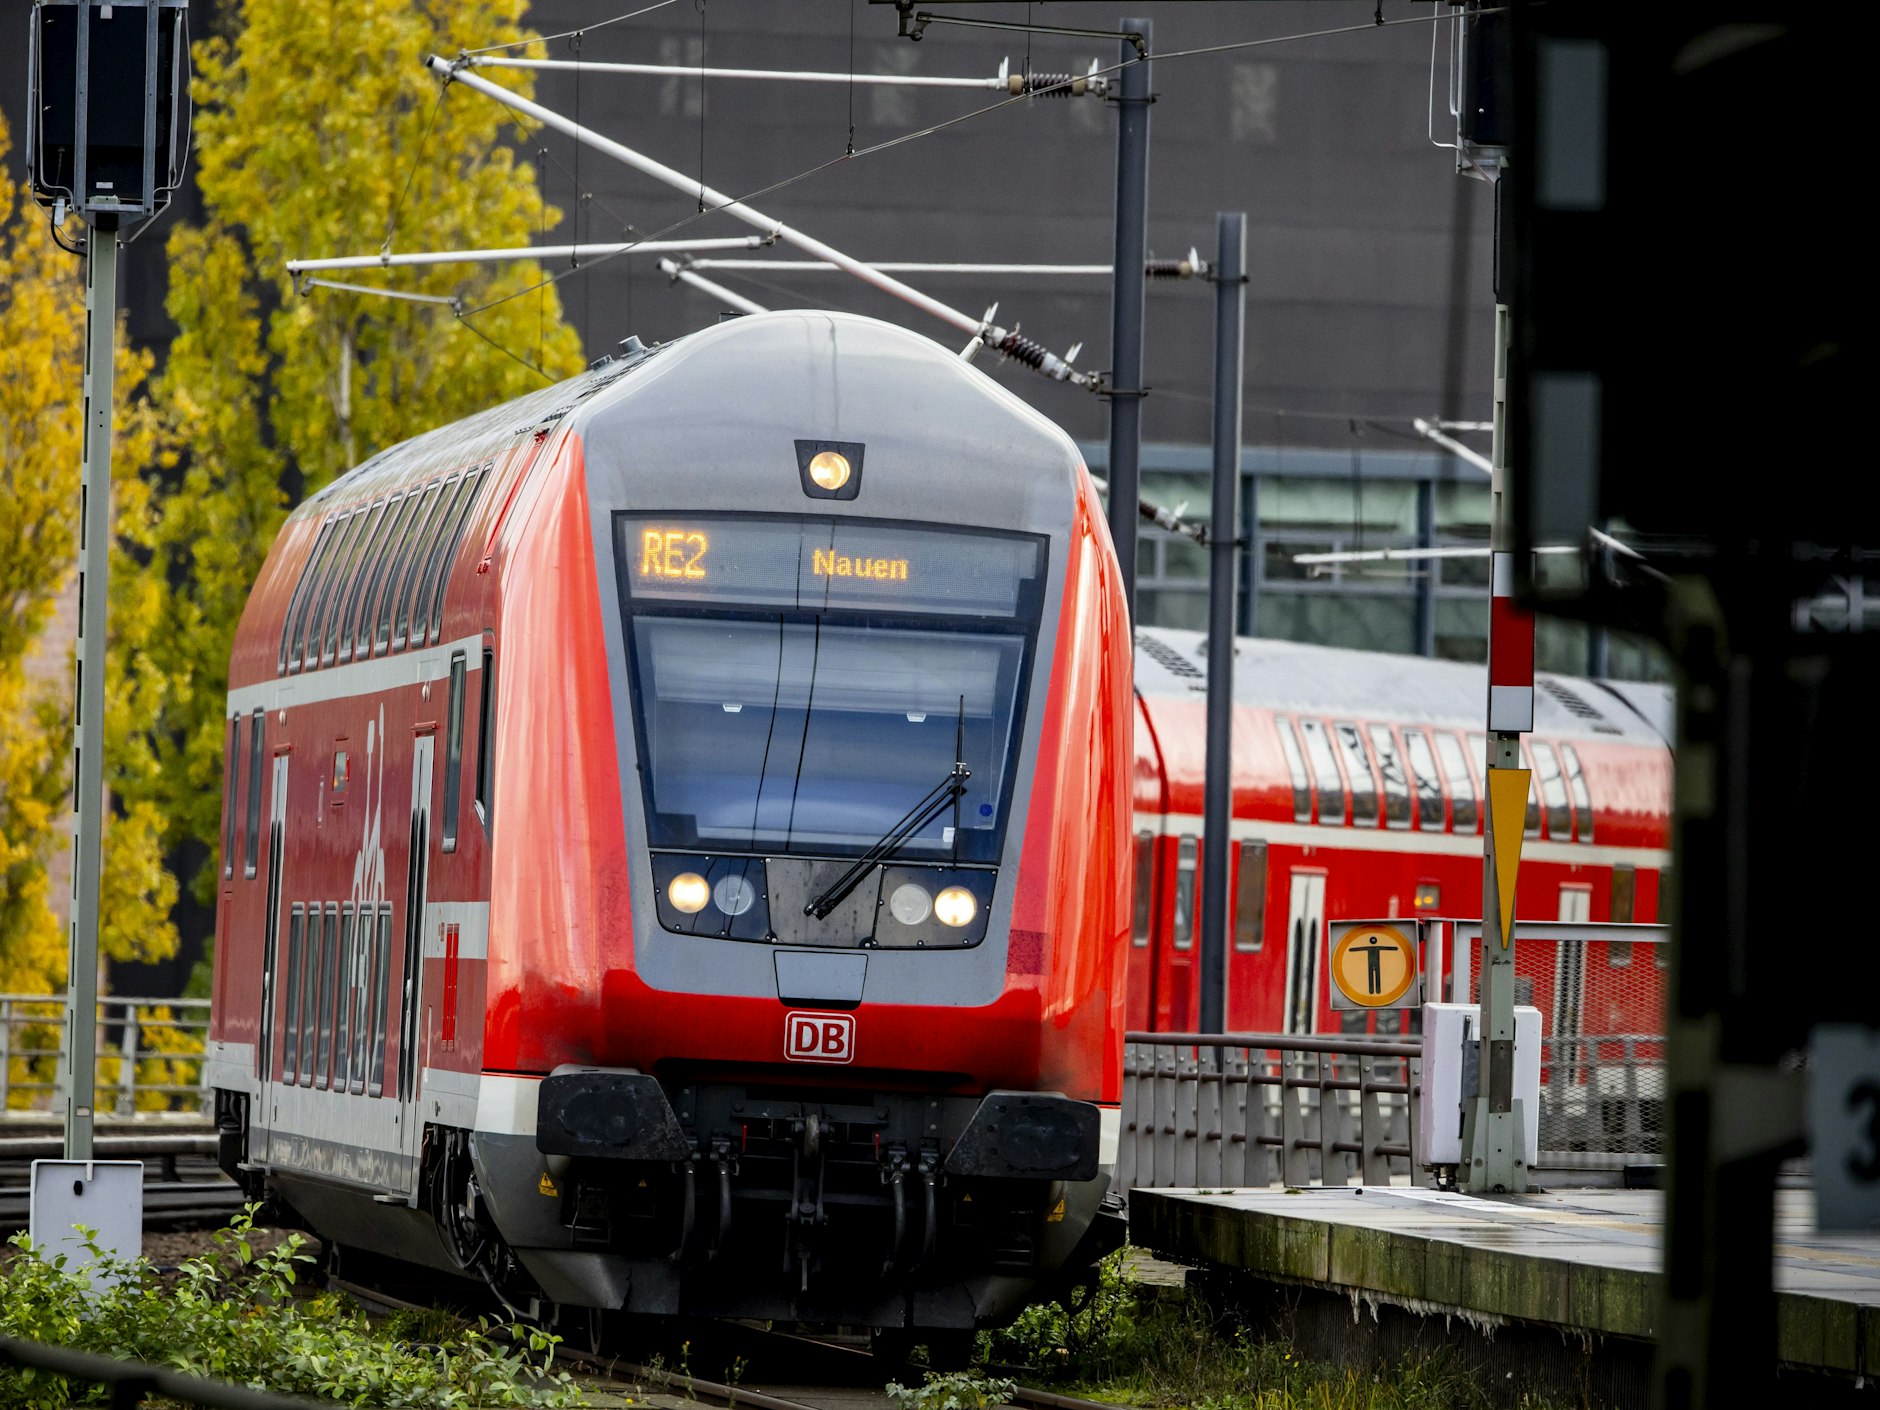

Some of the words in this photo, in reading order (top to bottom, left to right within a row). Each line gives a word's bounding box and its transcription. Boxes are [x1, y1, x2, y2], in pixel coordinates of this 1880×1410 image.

[641, 529, 708, 578] RE2
[813, 548, 909, 580] Nauen
[794, 1020, 846, 1055] DB
